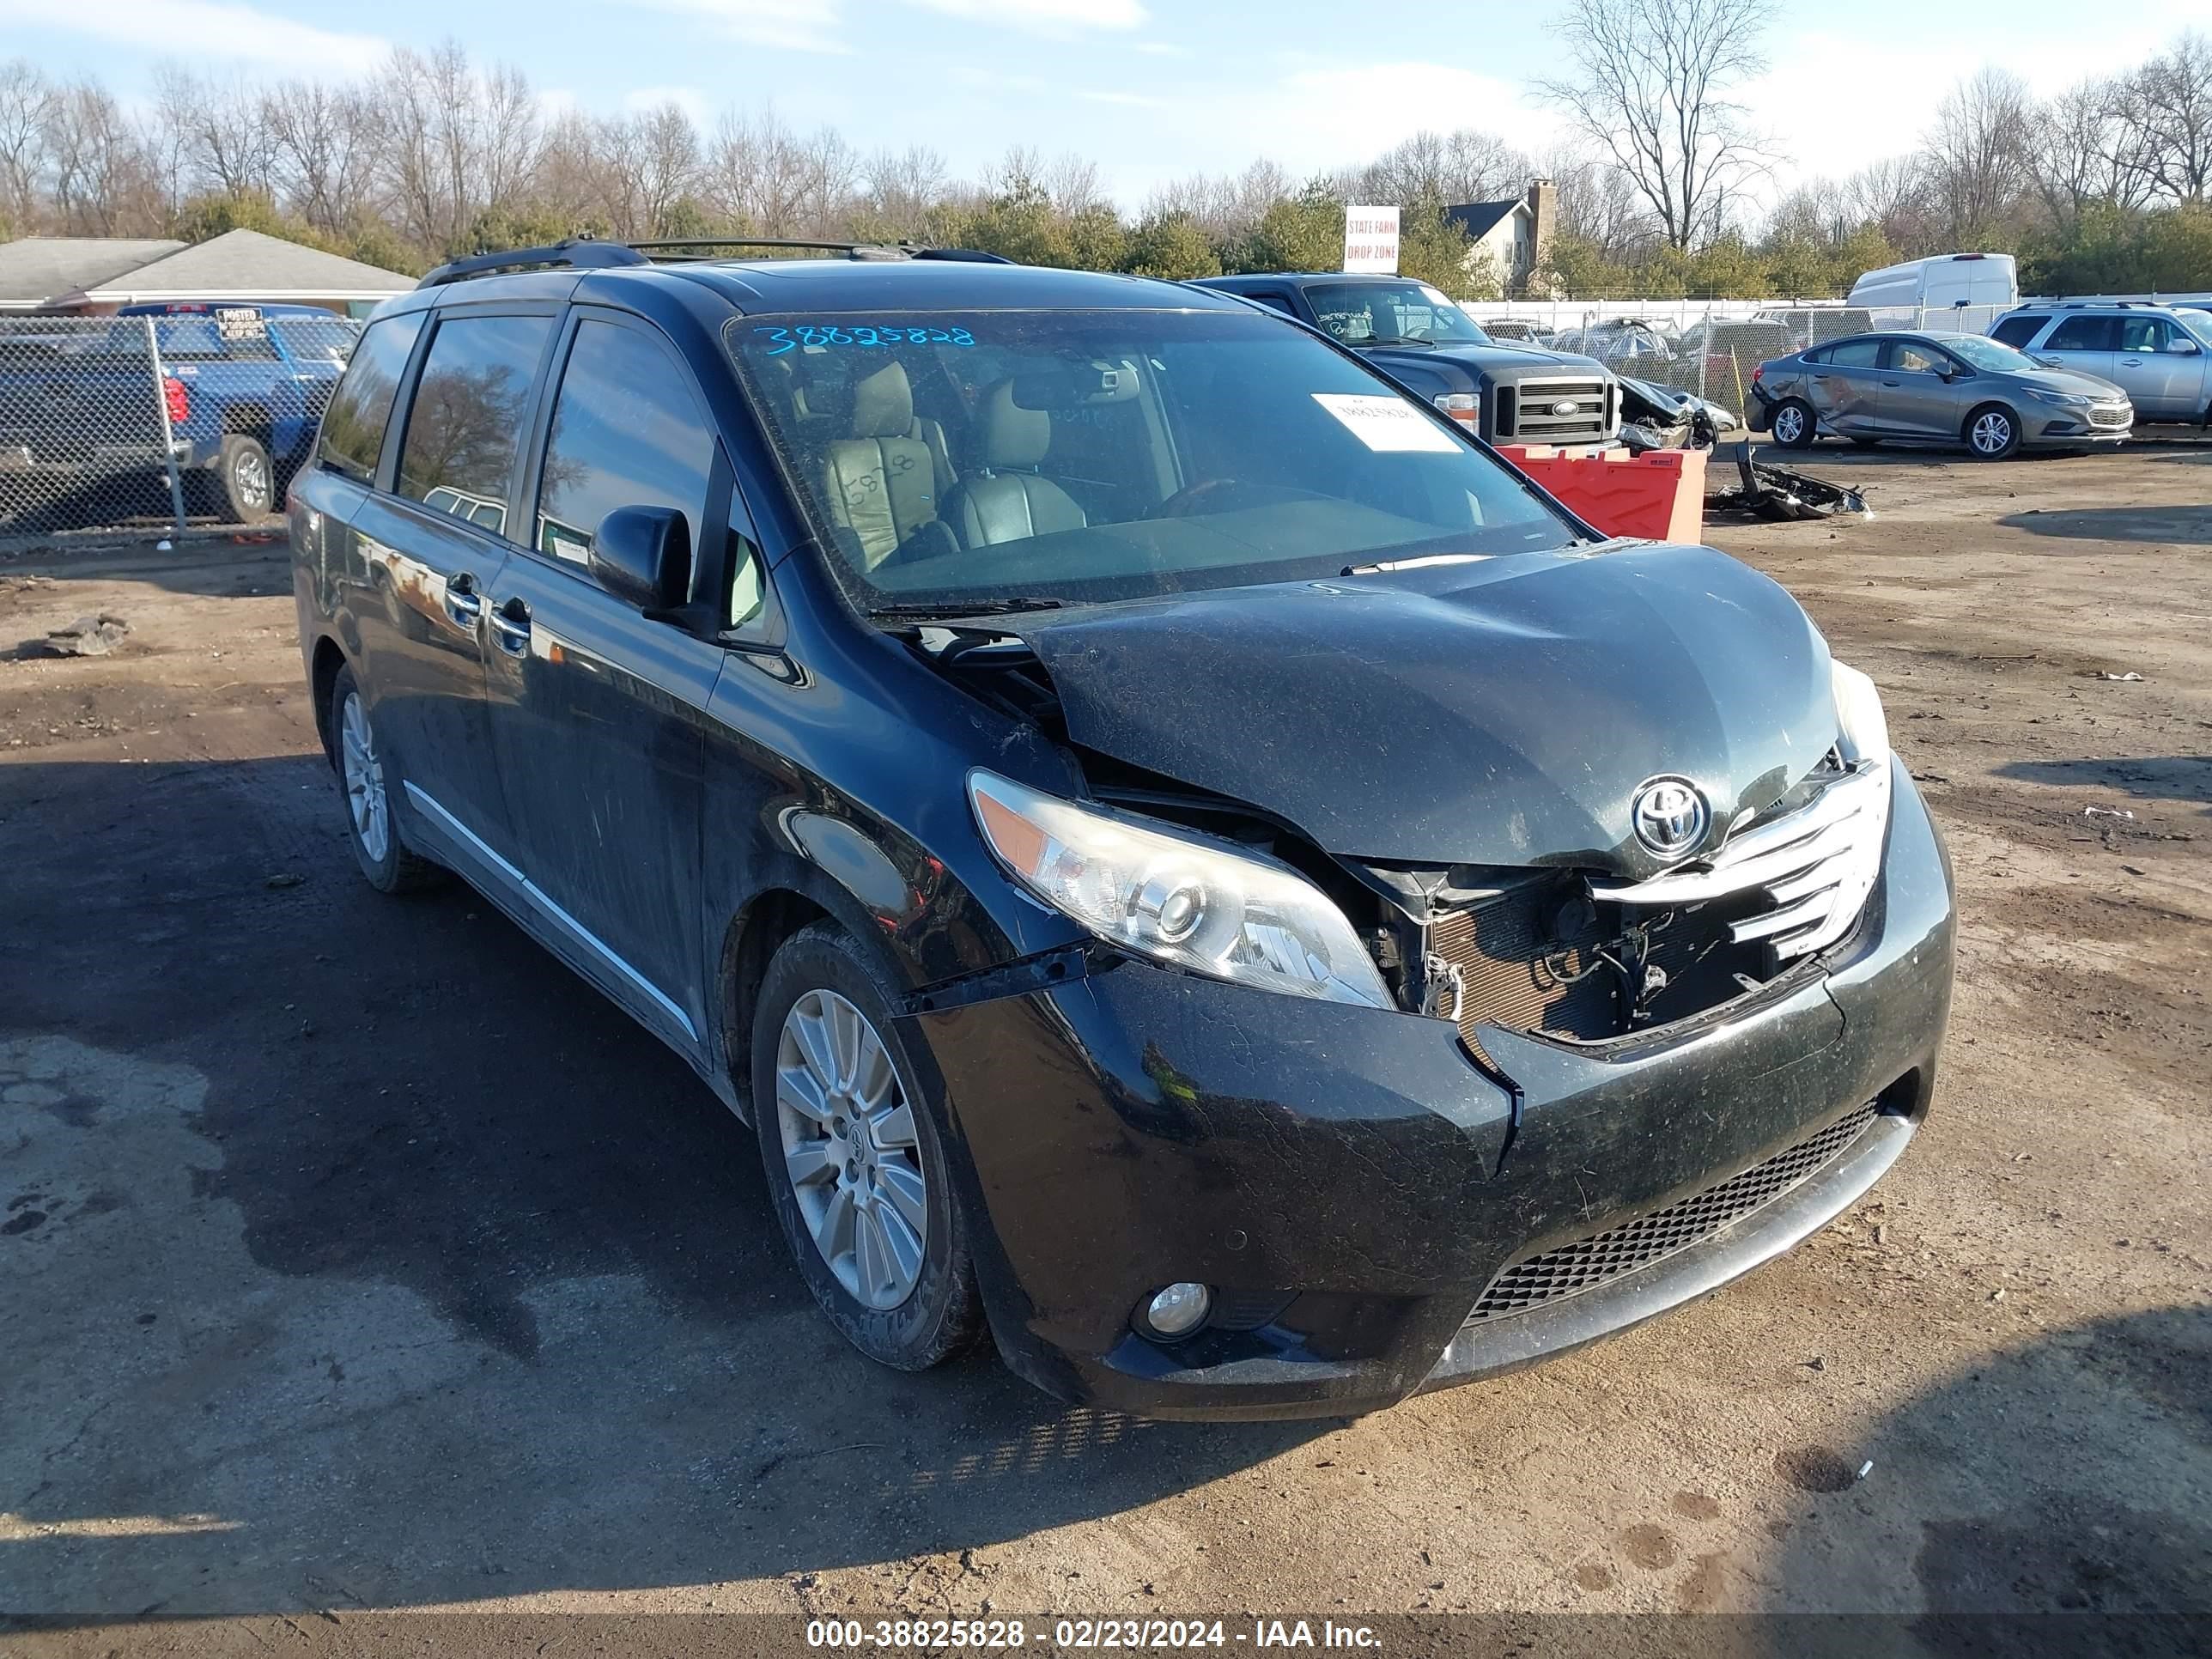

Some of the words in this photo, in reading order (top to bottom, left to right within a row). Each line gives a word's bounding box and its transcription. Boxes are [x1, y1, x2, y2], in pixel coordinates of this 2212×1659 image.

[1348, 220, 1372, 234] STATE
[1375, 220, 1396, 234] FARM
[1348, 245, 1371, 259] DROP
[1374, 245, 1395, 259] ZONE
[754, 326, 975, 355] 38825828
